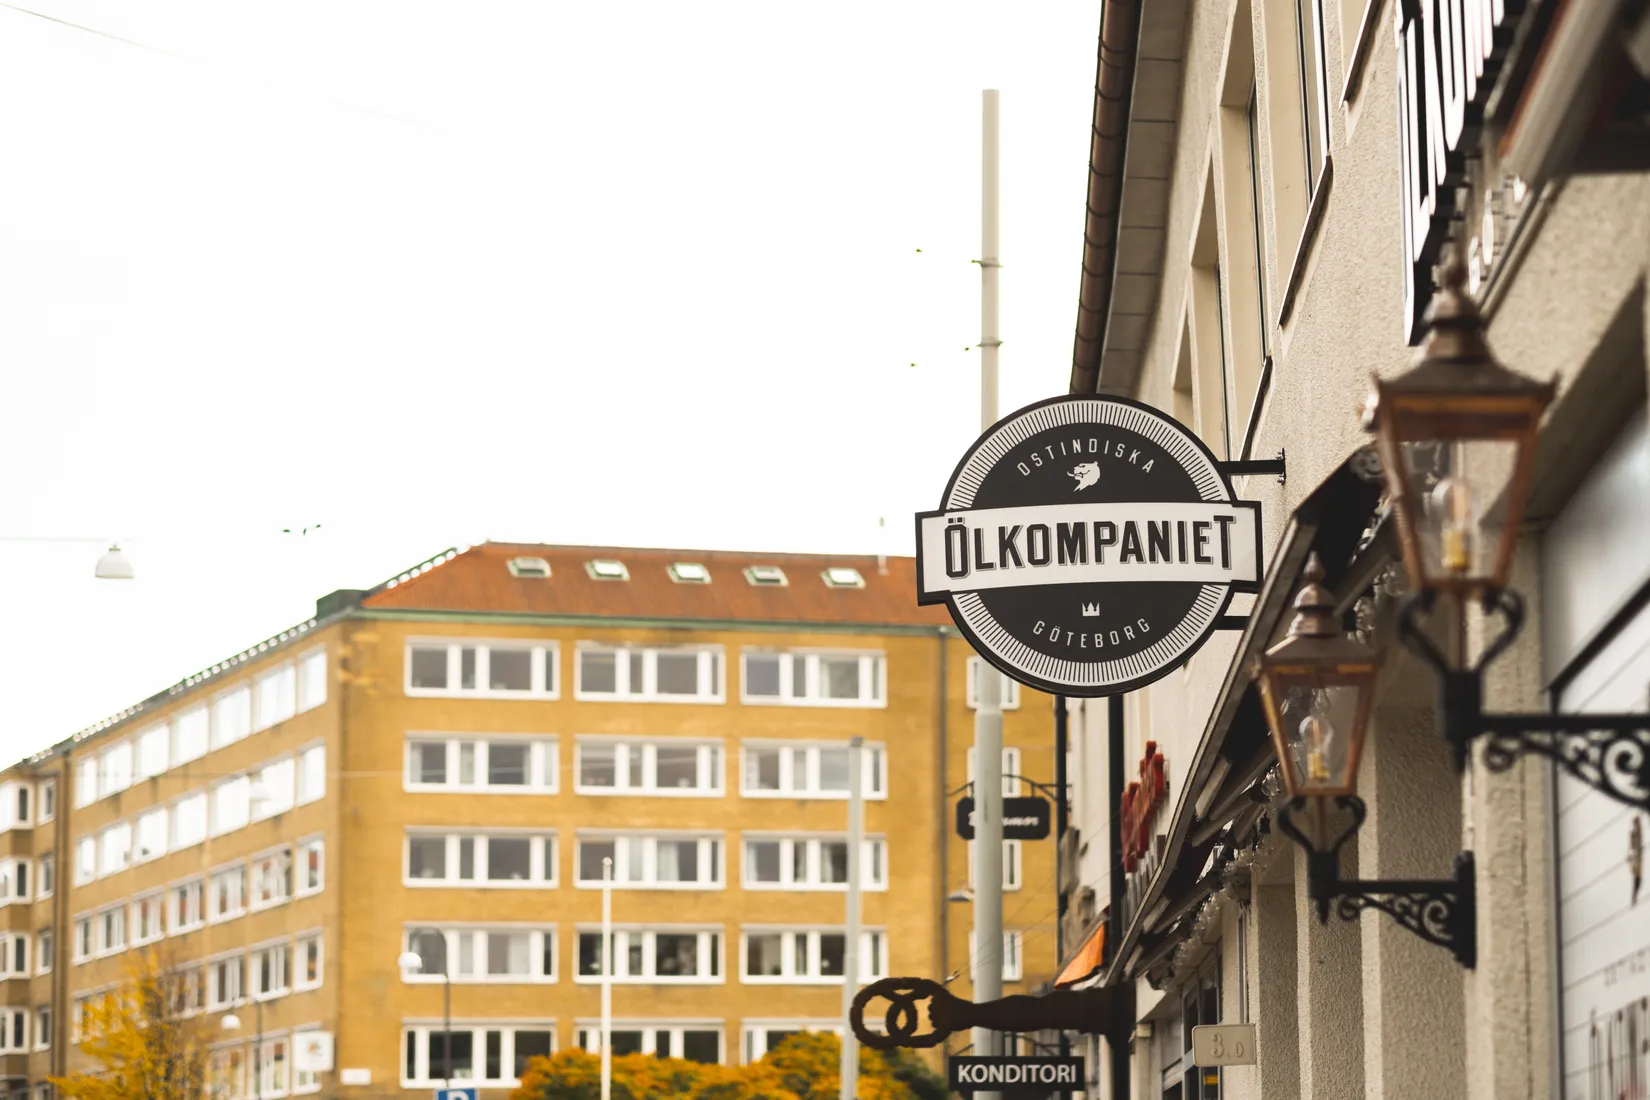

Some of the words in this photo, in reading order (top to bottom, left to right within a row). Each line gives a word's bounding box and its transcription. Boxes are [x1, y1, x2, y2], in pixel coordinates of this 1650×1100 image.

[1016, 438, 1155, 476] OSTINDISKA
[944, 514, 1237, 579] ÖLKOMPANIET
[1032, 618, 1151, 648] GÖTEBORG
[957, 1064, 1077, 1083] KONDITORI
